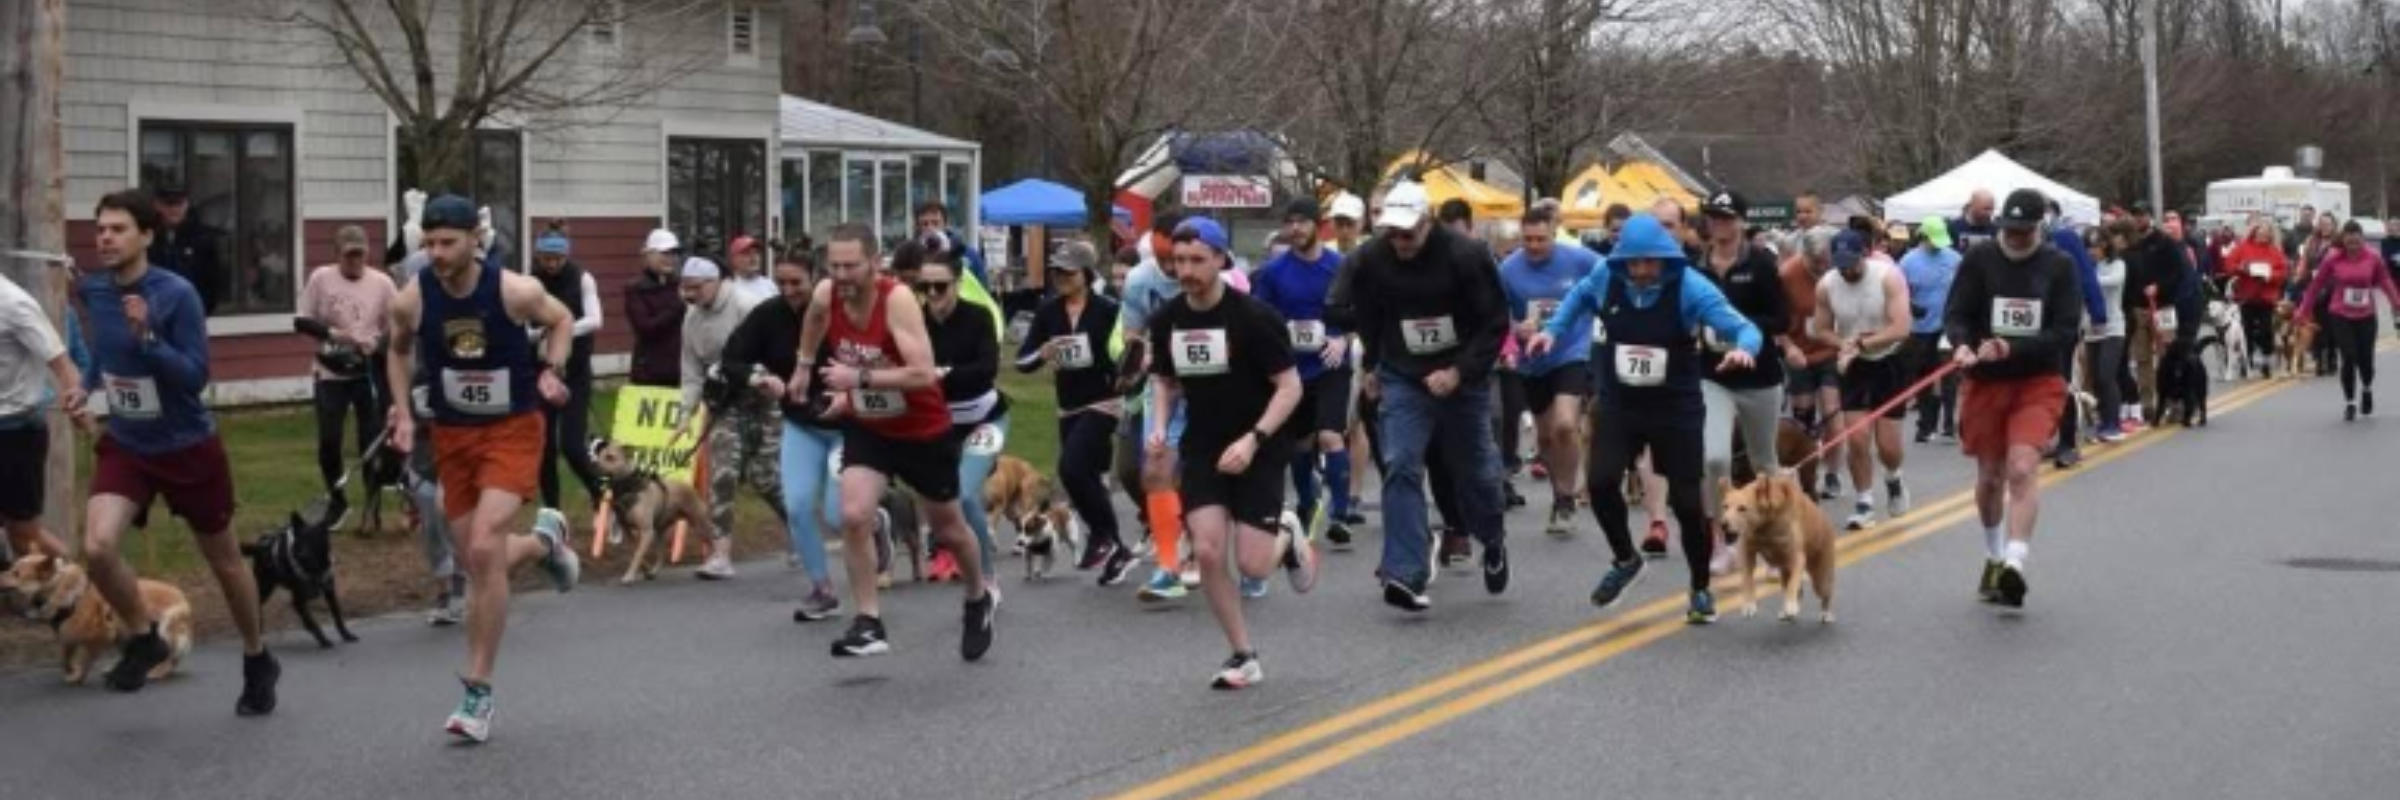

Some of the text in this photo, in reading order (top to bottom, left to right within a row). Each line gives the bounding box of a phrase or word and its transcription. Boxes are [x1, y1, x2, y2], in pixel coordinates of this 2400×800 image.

[2001, 309, 2033, 328] 190
[1418, 328, 1441, 345] 72
[1186, 344, 1211, 364] 65
[1627, 356, 1651, 375] 78
[115, 388, 141, 409] 79
[460, 384, 491, 403] 45
